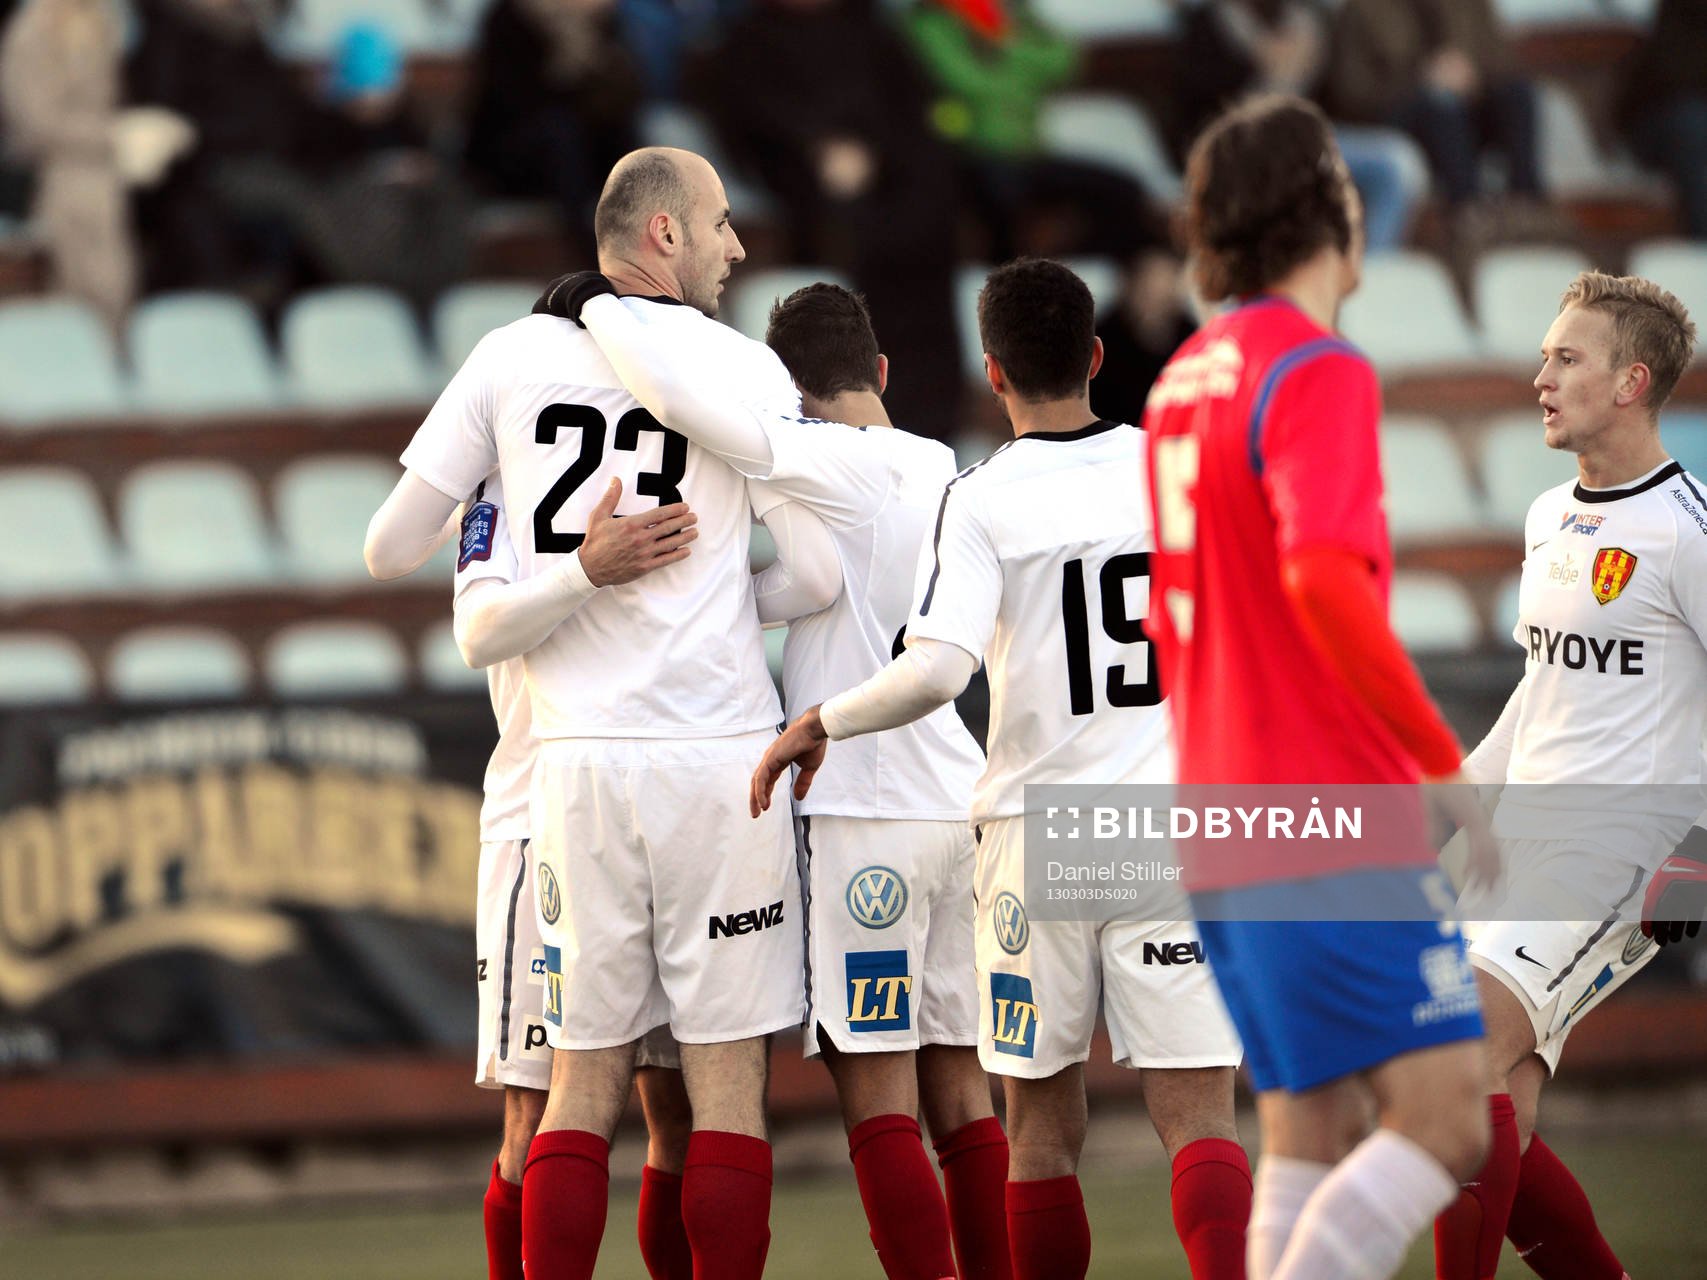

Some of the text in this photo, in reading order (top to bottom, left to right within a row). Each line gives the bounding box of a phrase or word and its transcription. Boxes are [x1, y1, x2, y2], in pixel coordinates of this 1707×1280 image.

[534, 403, 688, 554] 23
[1572, 523, 1599, 536] SPORT
[1576, 513, 1603, 527] INTER
[1670, 489, 1707, 535] AstraZeneca
[1548, 561, 1579, 585] Telge
[1062, 552, 1168, 715] 19
[1525, 624, 1644, 675] RYOYE
[1143, 941, 1207, 965] New
[846, 976, 912, 1022] LT
[992, 998, 1038, 1046] LT
